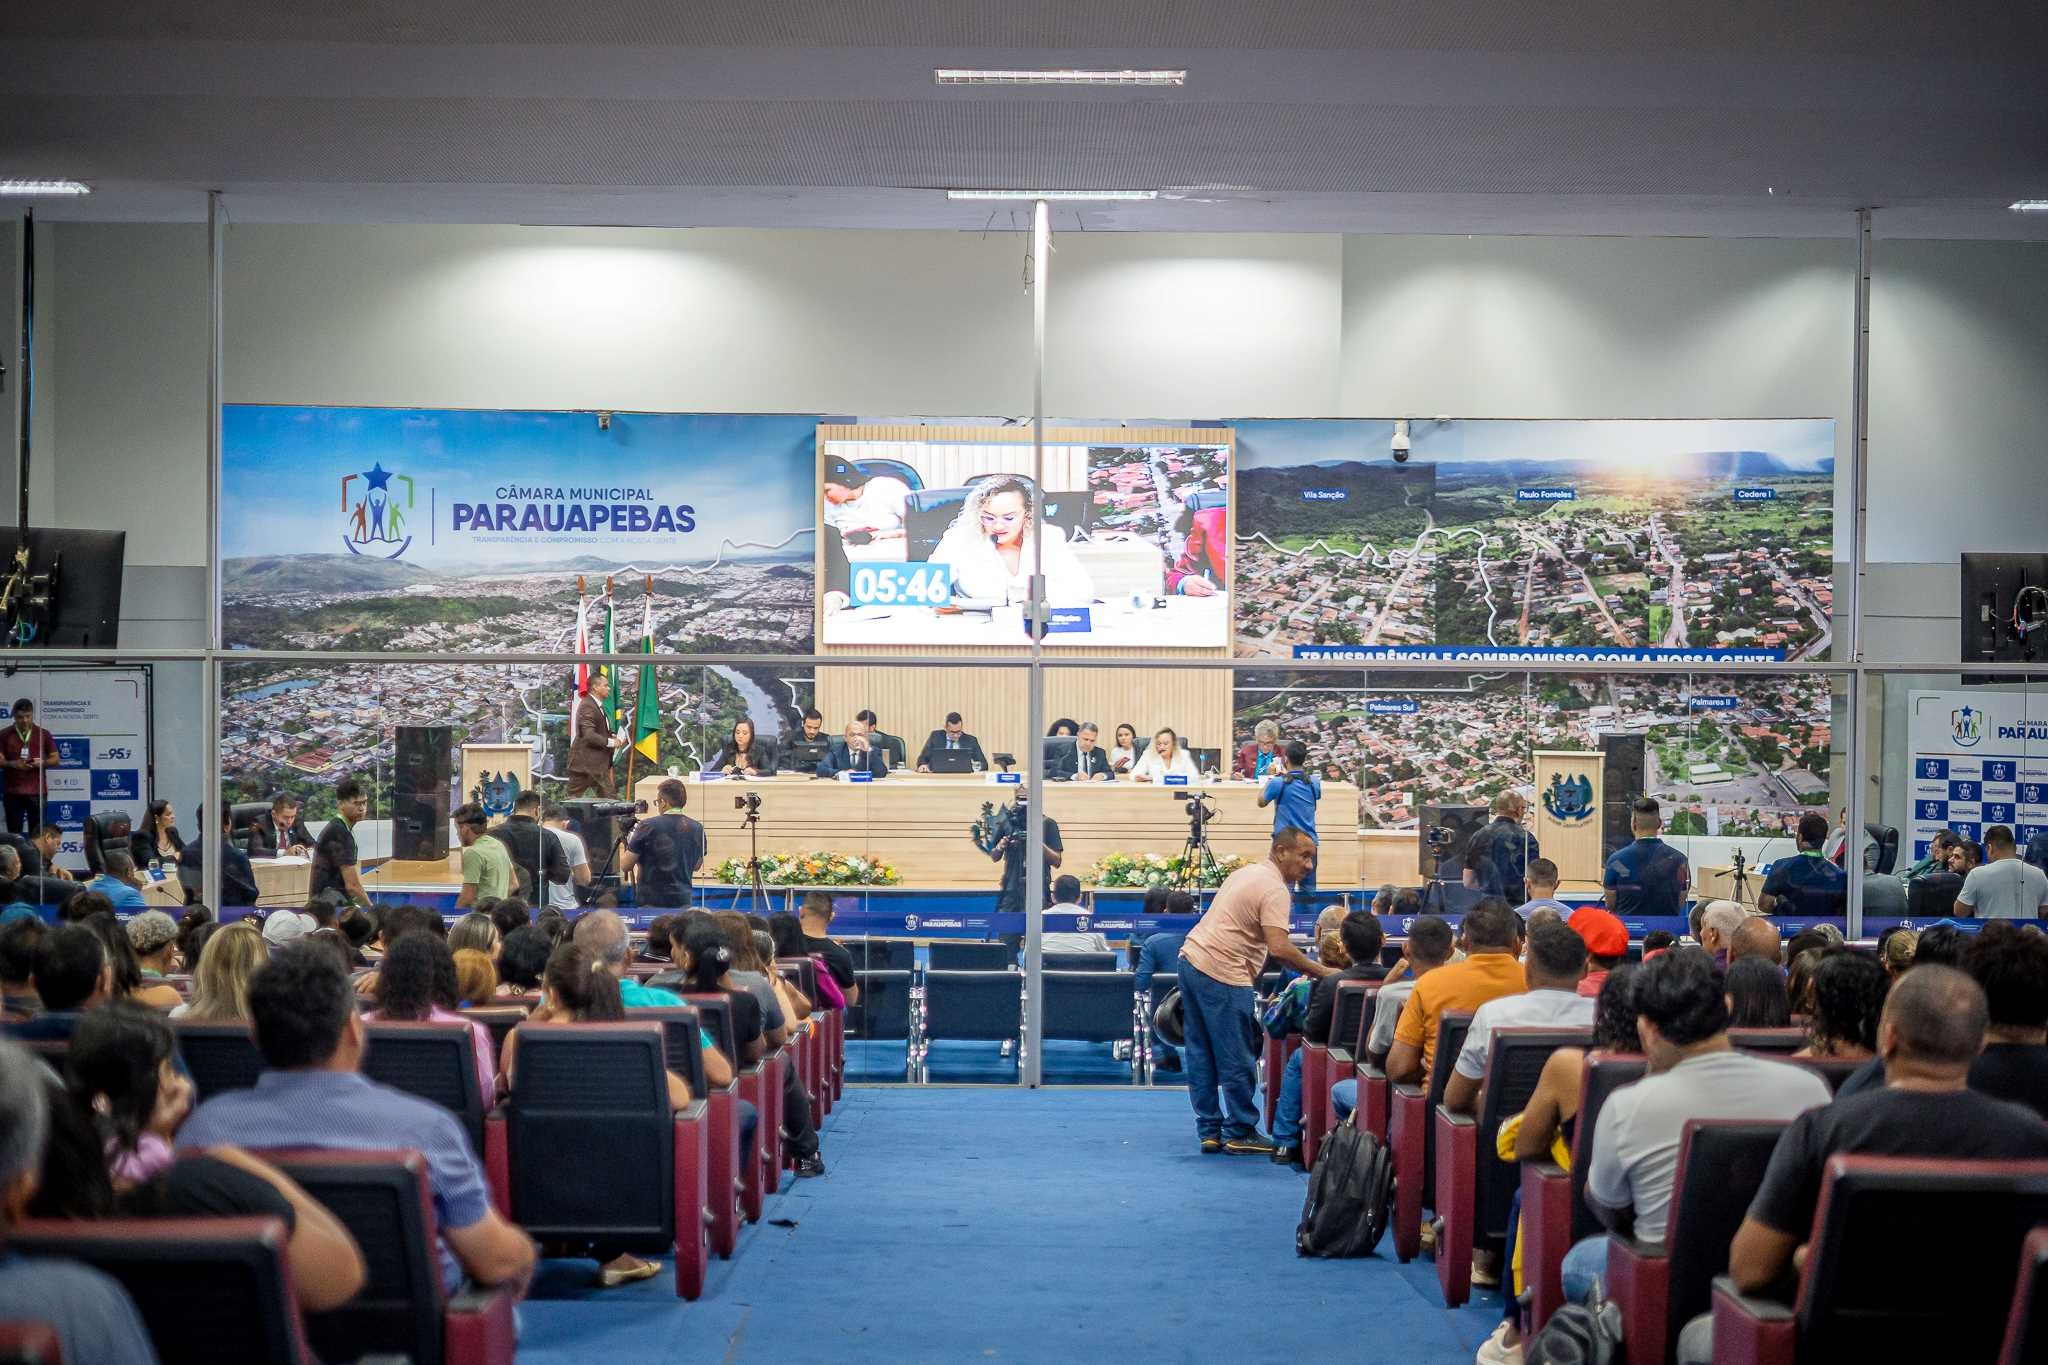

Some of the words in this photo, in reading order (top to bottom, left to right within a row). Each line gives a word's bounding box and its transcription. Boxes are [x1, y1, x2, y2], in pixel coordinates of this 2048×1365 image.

[496, 485, 564, 500] CÂMARA
[569, 487, 654, 501] MUNICIPAL
[1519, 490, 1540, 498] Paulo
[452, 503, 696, 533] PARAUAPEBAS
[472, 535, 533, 544] TRANSPARÊNCIA
[541, 536, 598, 545] COMPROMISSO
[854, 568, 947, 603] 05:46
[1300, 649, 1437, 661] TRANSPARÊNCIA
[1691, 698, 1724, 706] Palmares
